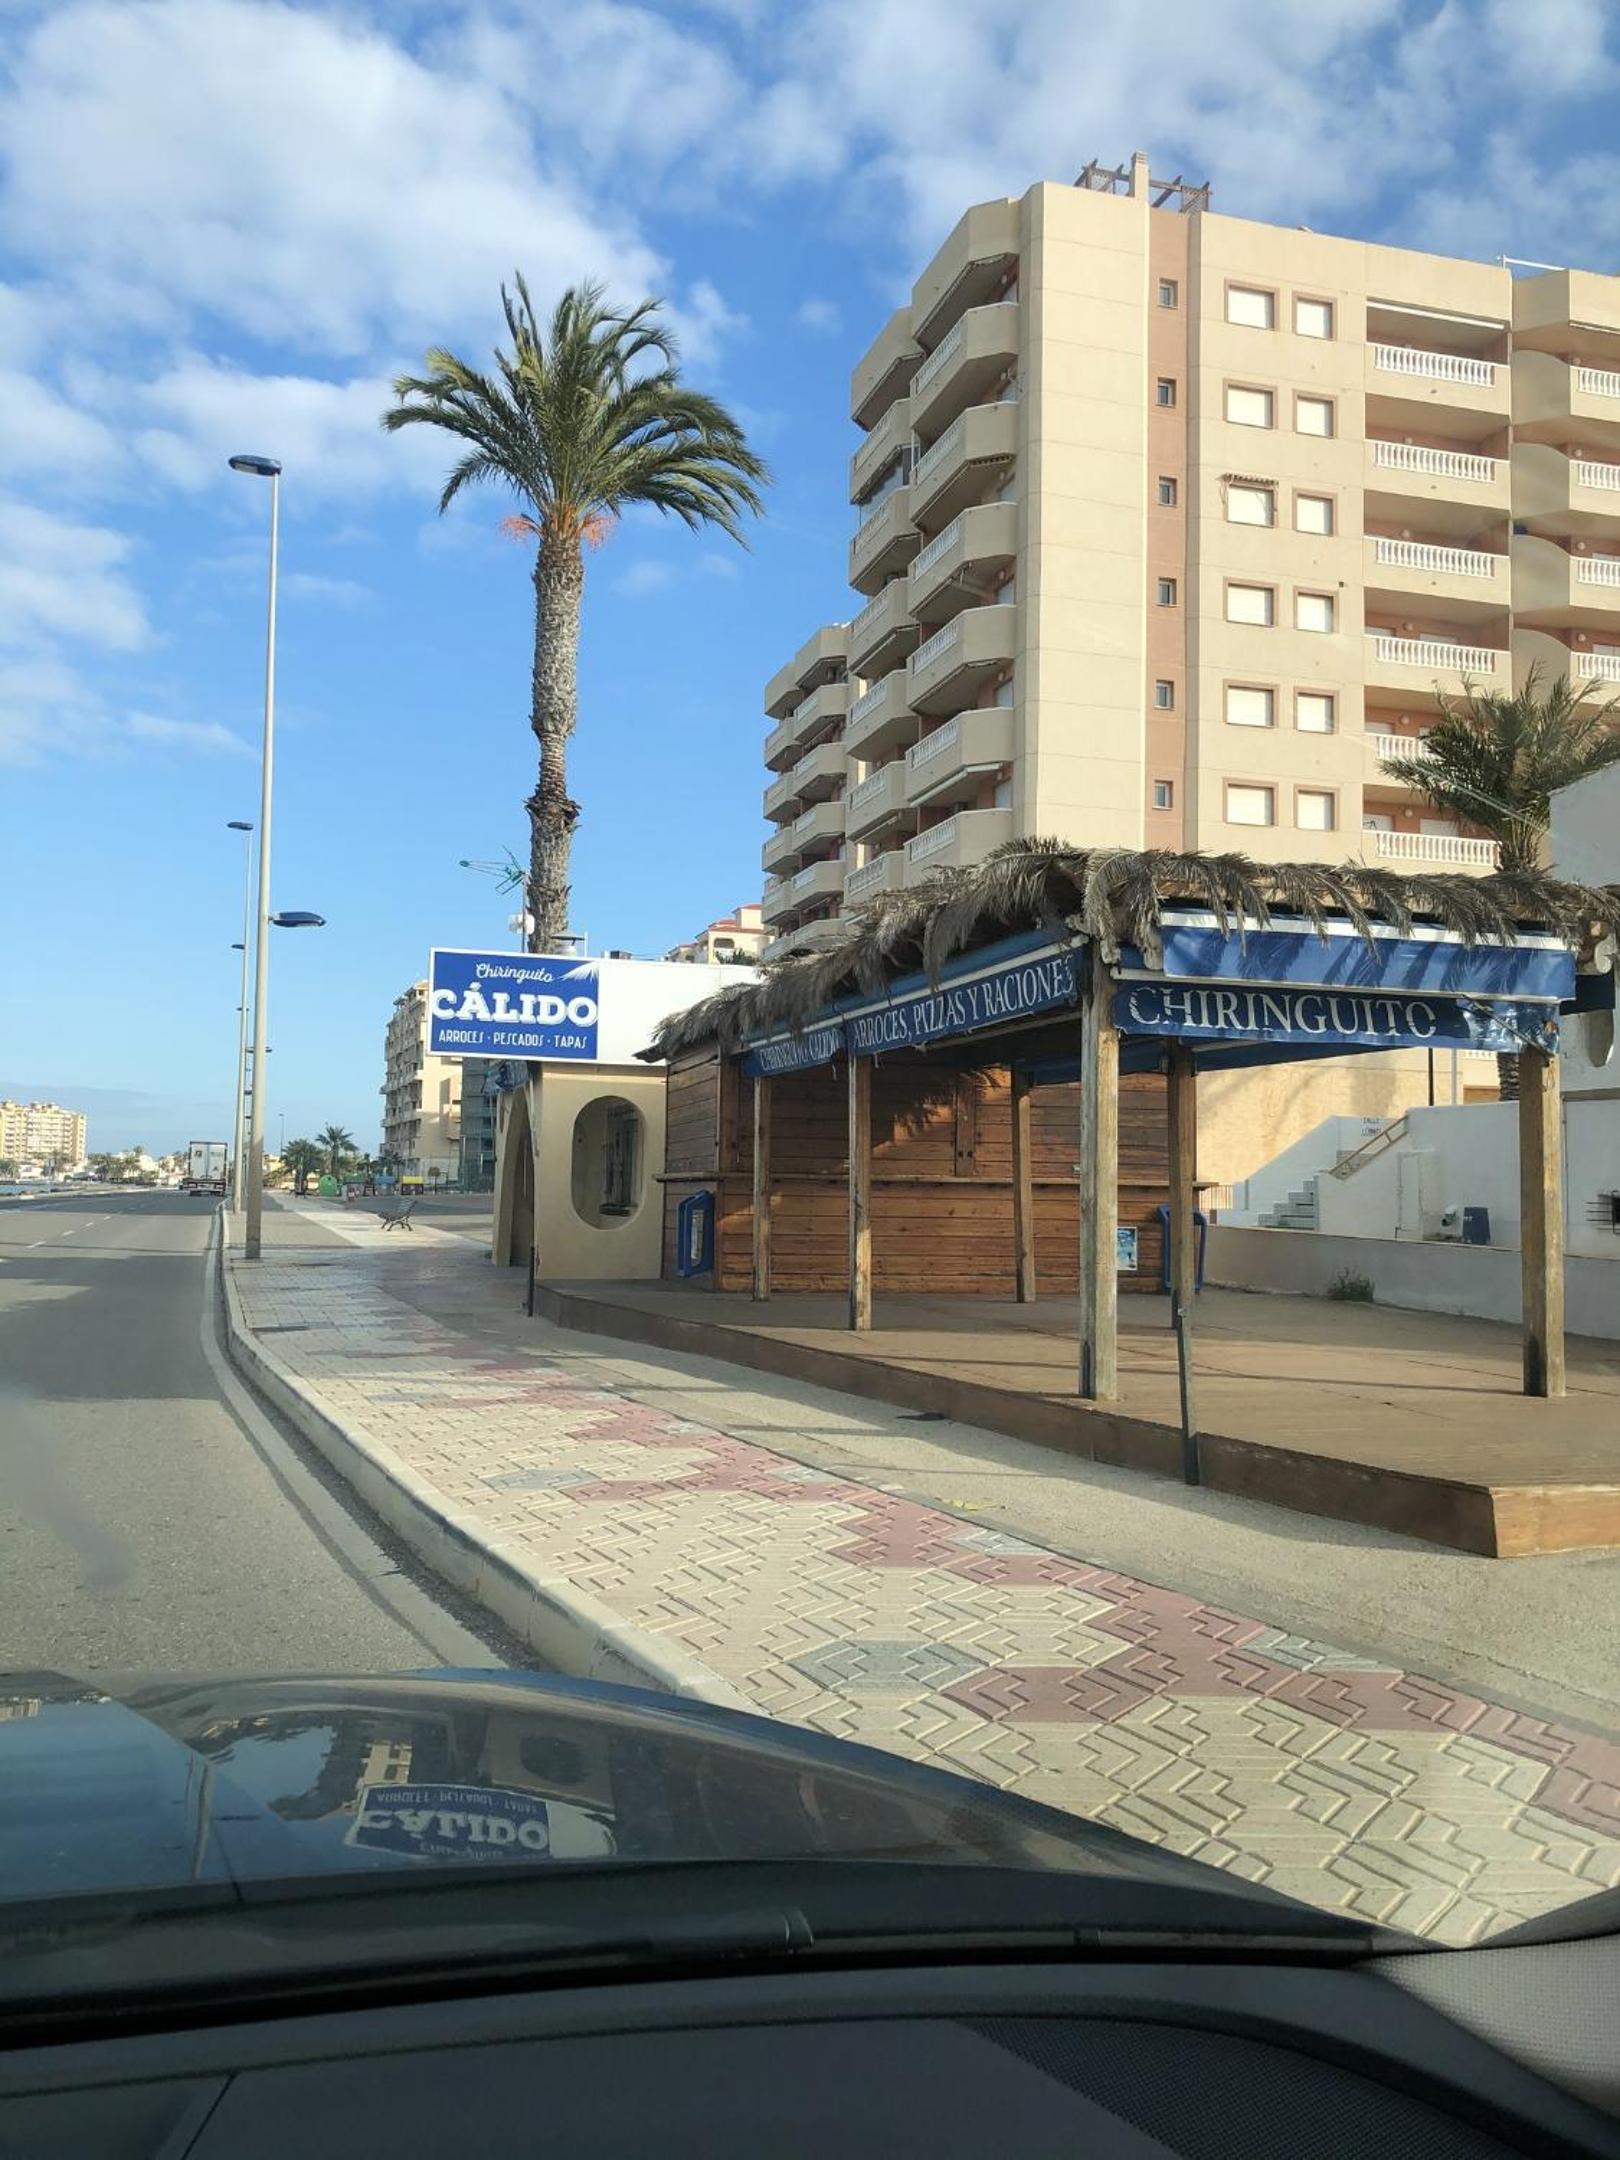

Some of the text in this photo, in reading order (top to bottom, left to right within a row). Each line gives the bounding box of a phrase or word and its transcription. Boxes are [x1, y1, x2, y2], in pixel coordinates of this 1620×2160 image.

[476, 962, 555, 984] Chiringuito
[432, 981, 598, 1028] CÁLIDO
[913, 990, 966, 1036] PIZZAS
[966, 986, 980, 1021] Y
[1129, 986, 1437, 1038] CHIRINGUITO
[438, 1029, 588, 1050] ARROCES PESCADOS TAPAS
